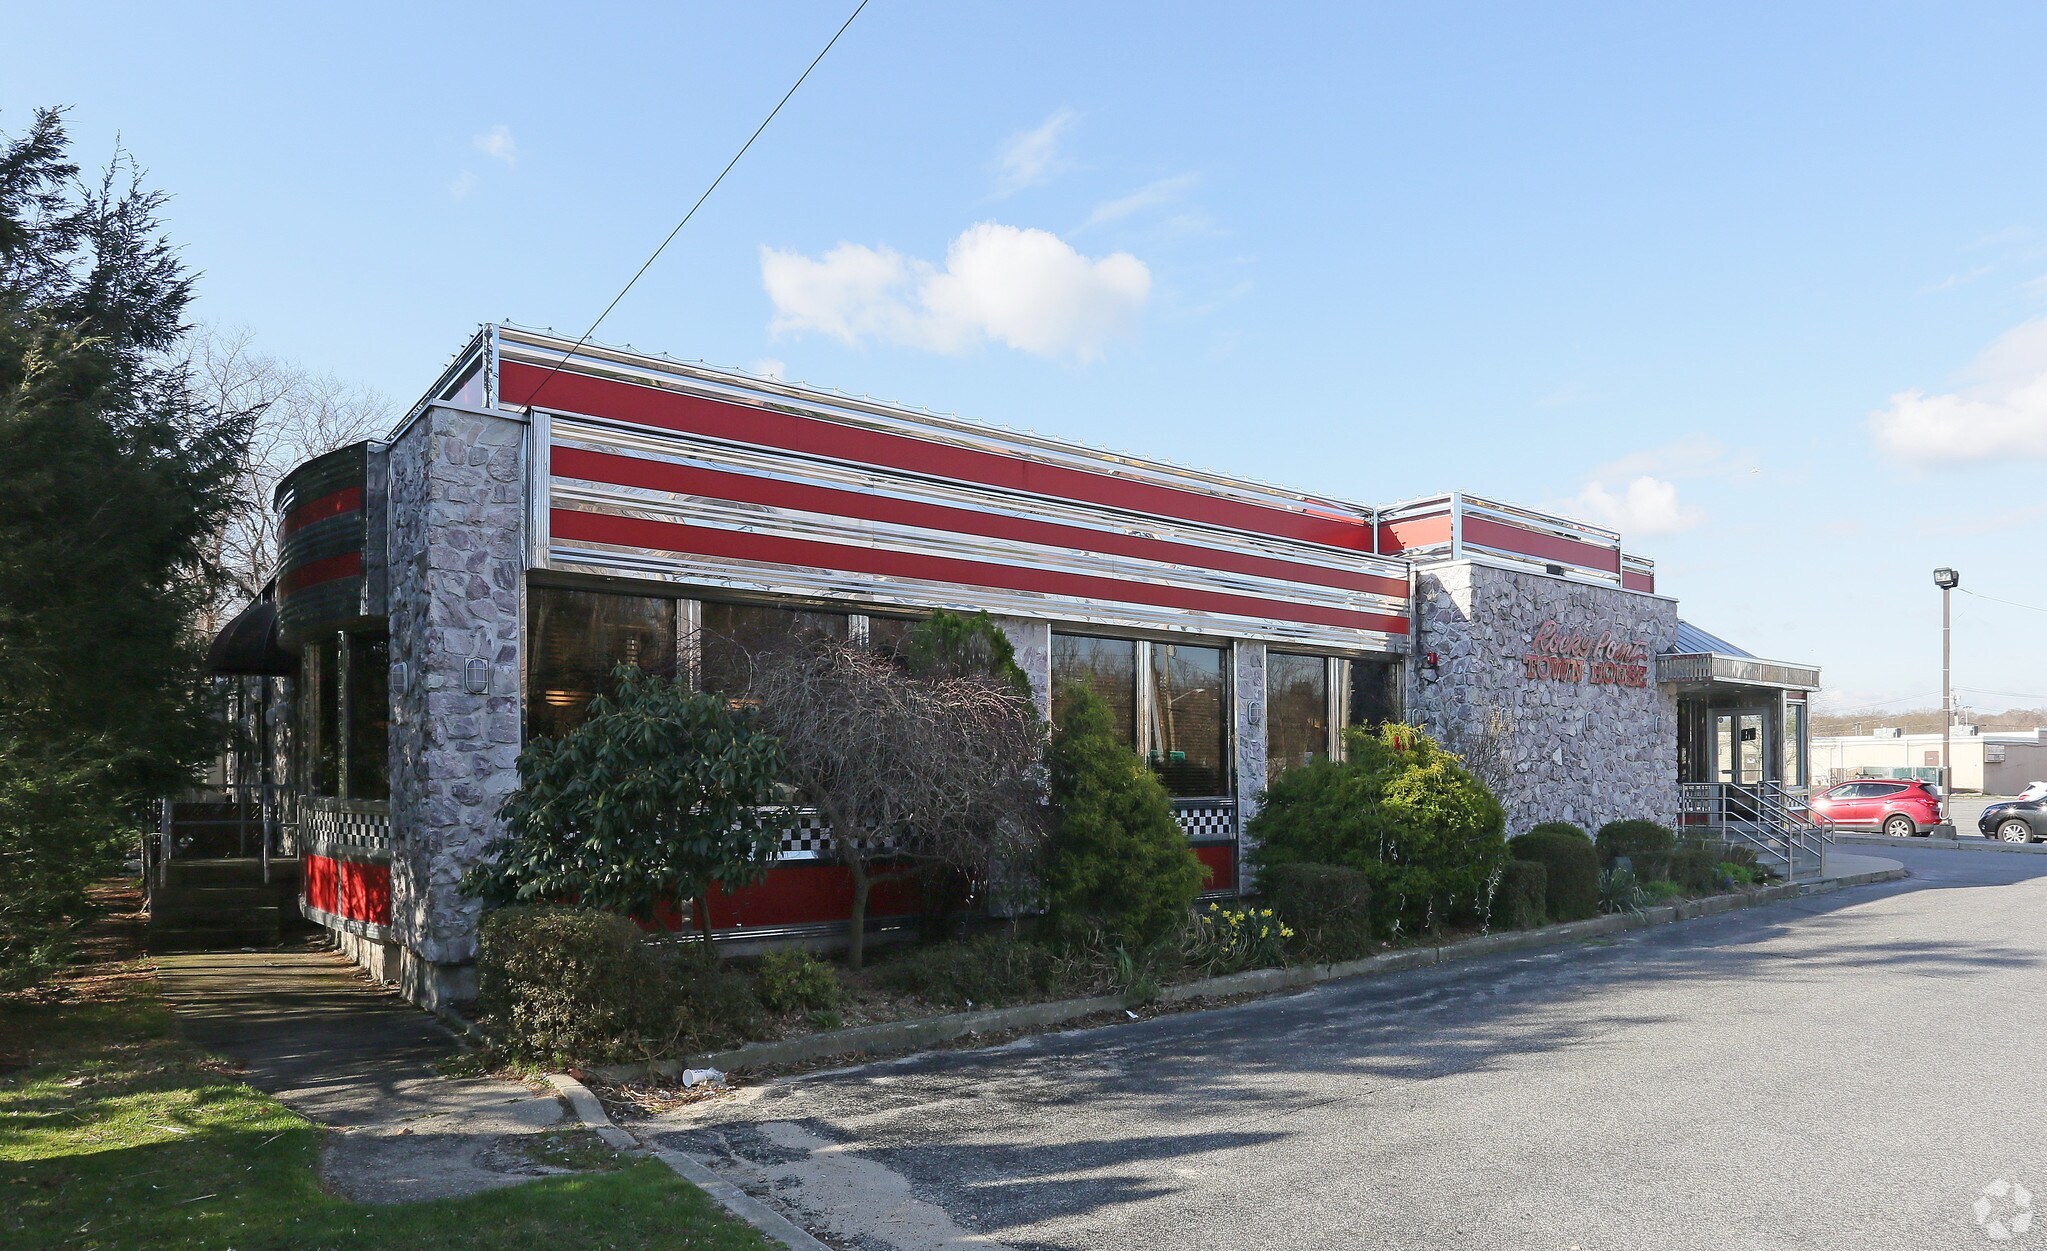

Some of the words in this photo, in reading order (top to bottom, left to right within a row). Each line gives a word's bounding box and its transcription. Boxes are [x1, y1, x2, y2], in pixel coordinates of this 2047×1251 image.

[1532, 620, 1594, 657] Rocky
[1592, 630, 1648, 662] Point
[1523, 653, 1584, 683] TOWN
[1591, 661, 1647, 688] HOUSE
